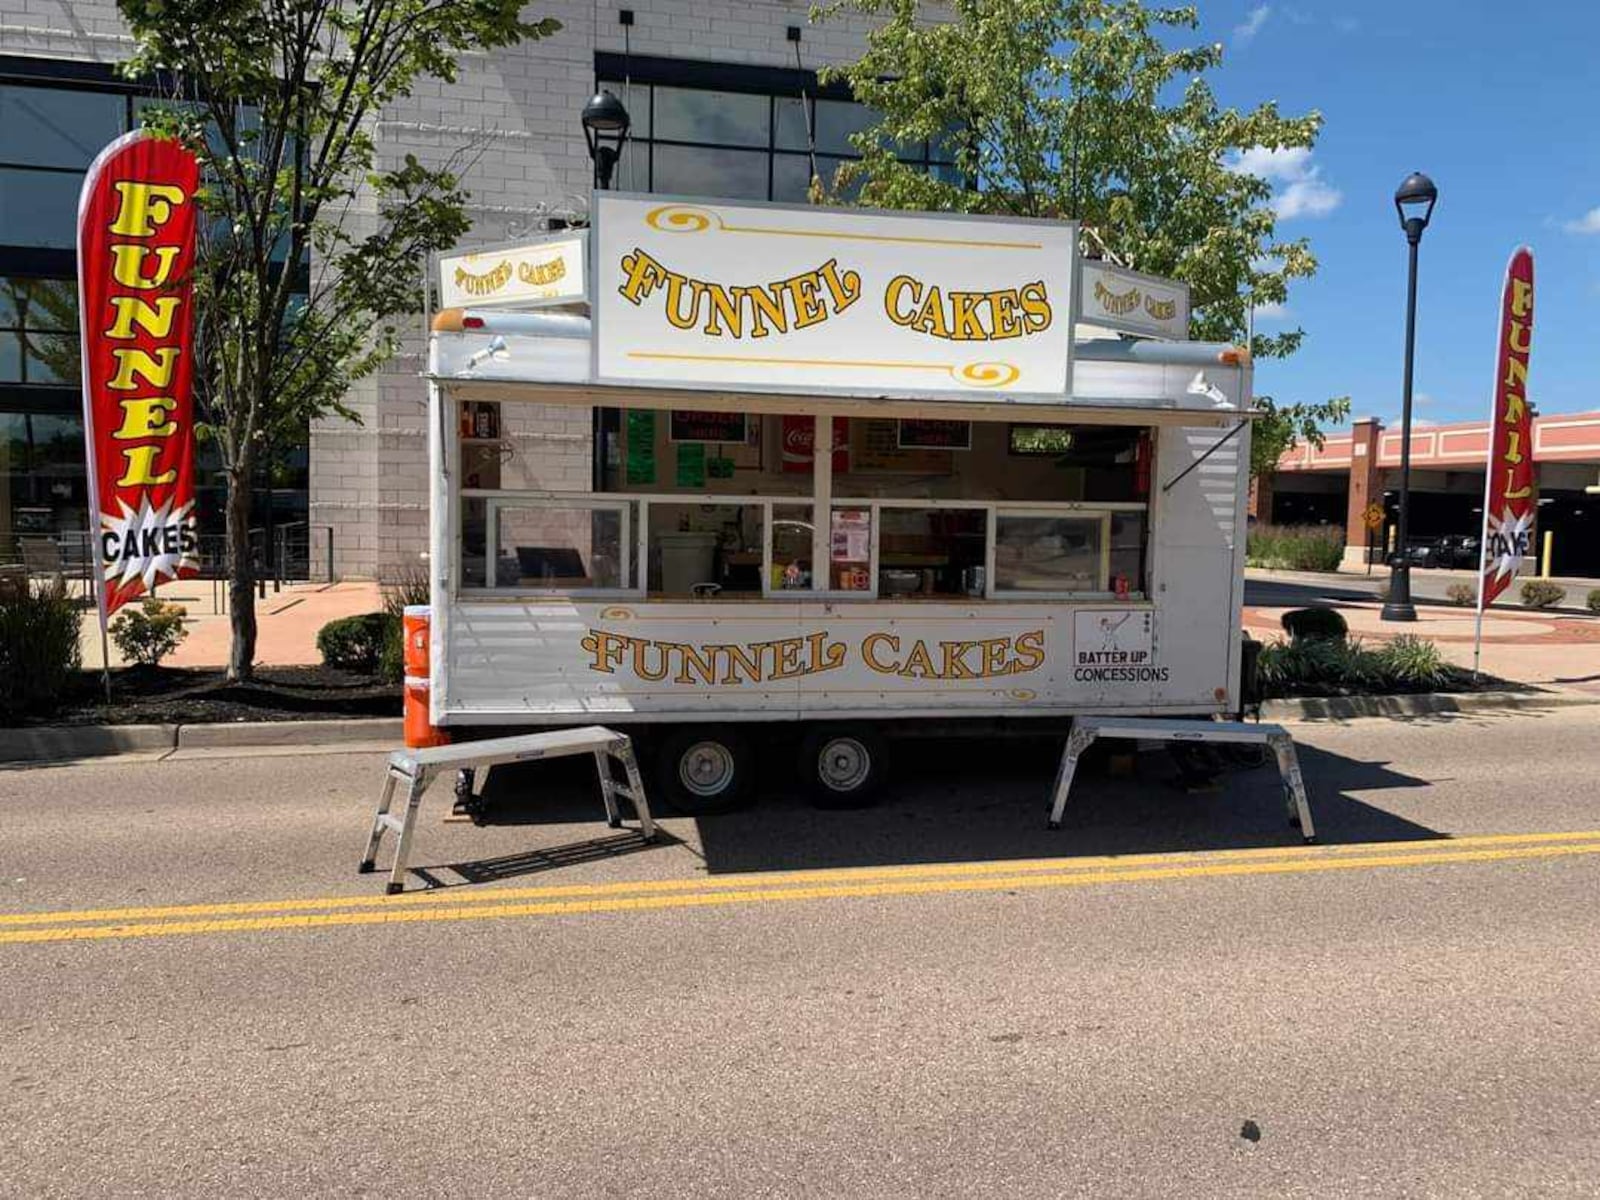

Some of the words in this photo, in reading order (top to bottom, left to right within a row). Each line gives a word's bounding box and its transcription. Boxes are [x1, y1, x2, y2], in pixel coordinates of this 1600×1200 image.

[455, 259, 513, 295] FUNNEL
[518, 256, 566, 286] CAKES
[618, 247, 861, 339] FUNNEL
[884, 275, 1053, 341] CAKES
[1095, 281, 1141, 316] FUNNEL
[104, 180, 185, 488] FUNNEL
[102, 523, 198, 562] CAKES
[580, 629, 847, 684] FUNNEL
[861, 630, 1045, 679] CAKES
[1074, 667, 1170, 682] CONCESSIONS
[1078, 651, 1128, 664] BATTER
[1131, 651, 1148, 663] UP
